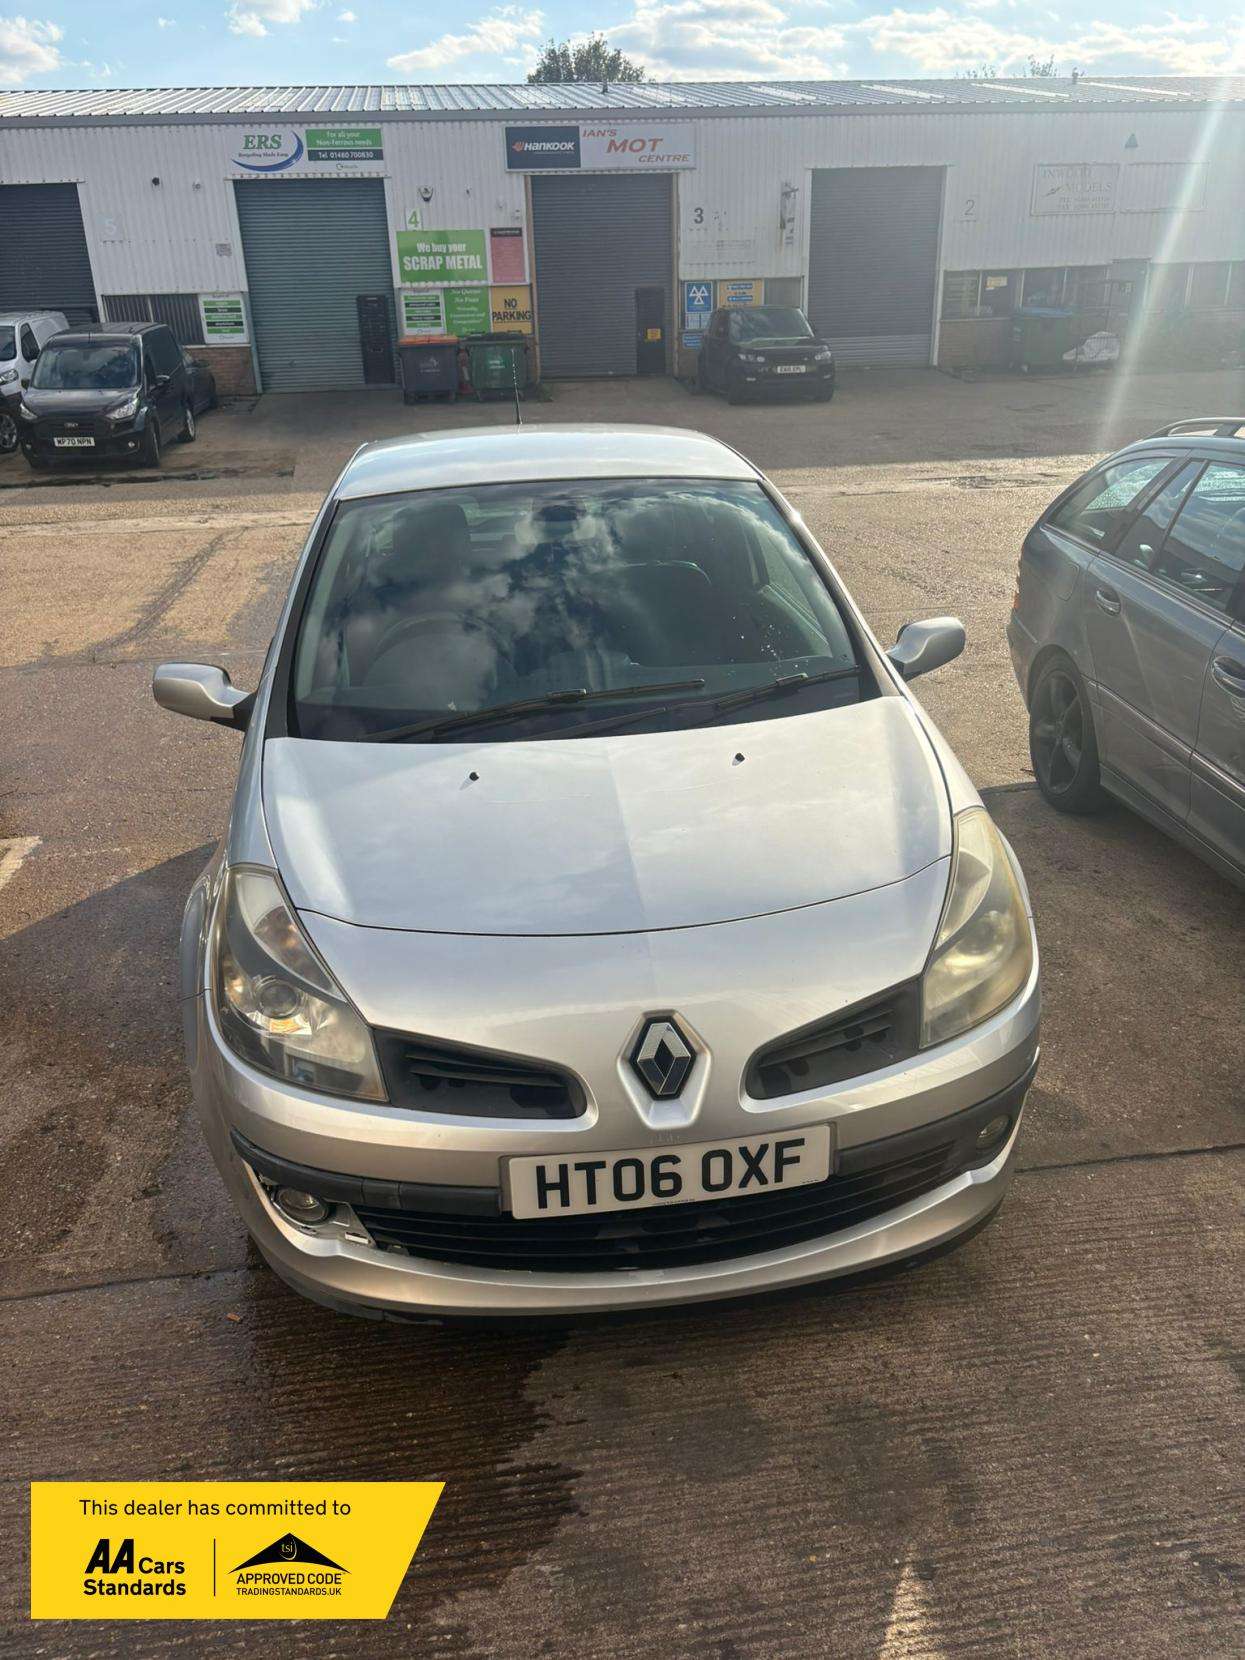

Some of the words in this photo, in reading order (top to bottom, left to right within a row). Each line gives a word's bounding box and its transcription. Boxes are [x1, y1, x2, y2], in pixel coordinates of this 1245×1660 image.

[582, 129, 616, 138] IAN'S
[243, 134, 282, 150] ERS
[607, 138, 662, 153] MOT
[638, 154, 690, 163] CENTRE
[964, 200, 975, 216] 2
[409, 210, 420, 228] 4
[694, 208, 704, 224] 3
[417, 243, 431, 253] We
[432, 243, 446, 254] buy
[448, 243, 466, 254] your
[403, 256, 443, 270] SCRAP
[445, 255, 483, 270] METAL
[504, 298, 518, 308] NO
[492, 311, 532, 321] PARKING
[536, 1154, 682, 1210] HT06
[701, 1138, 806, 1192] OXF
